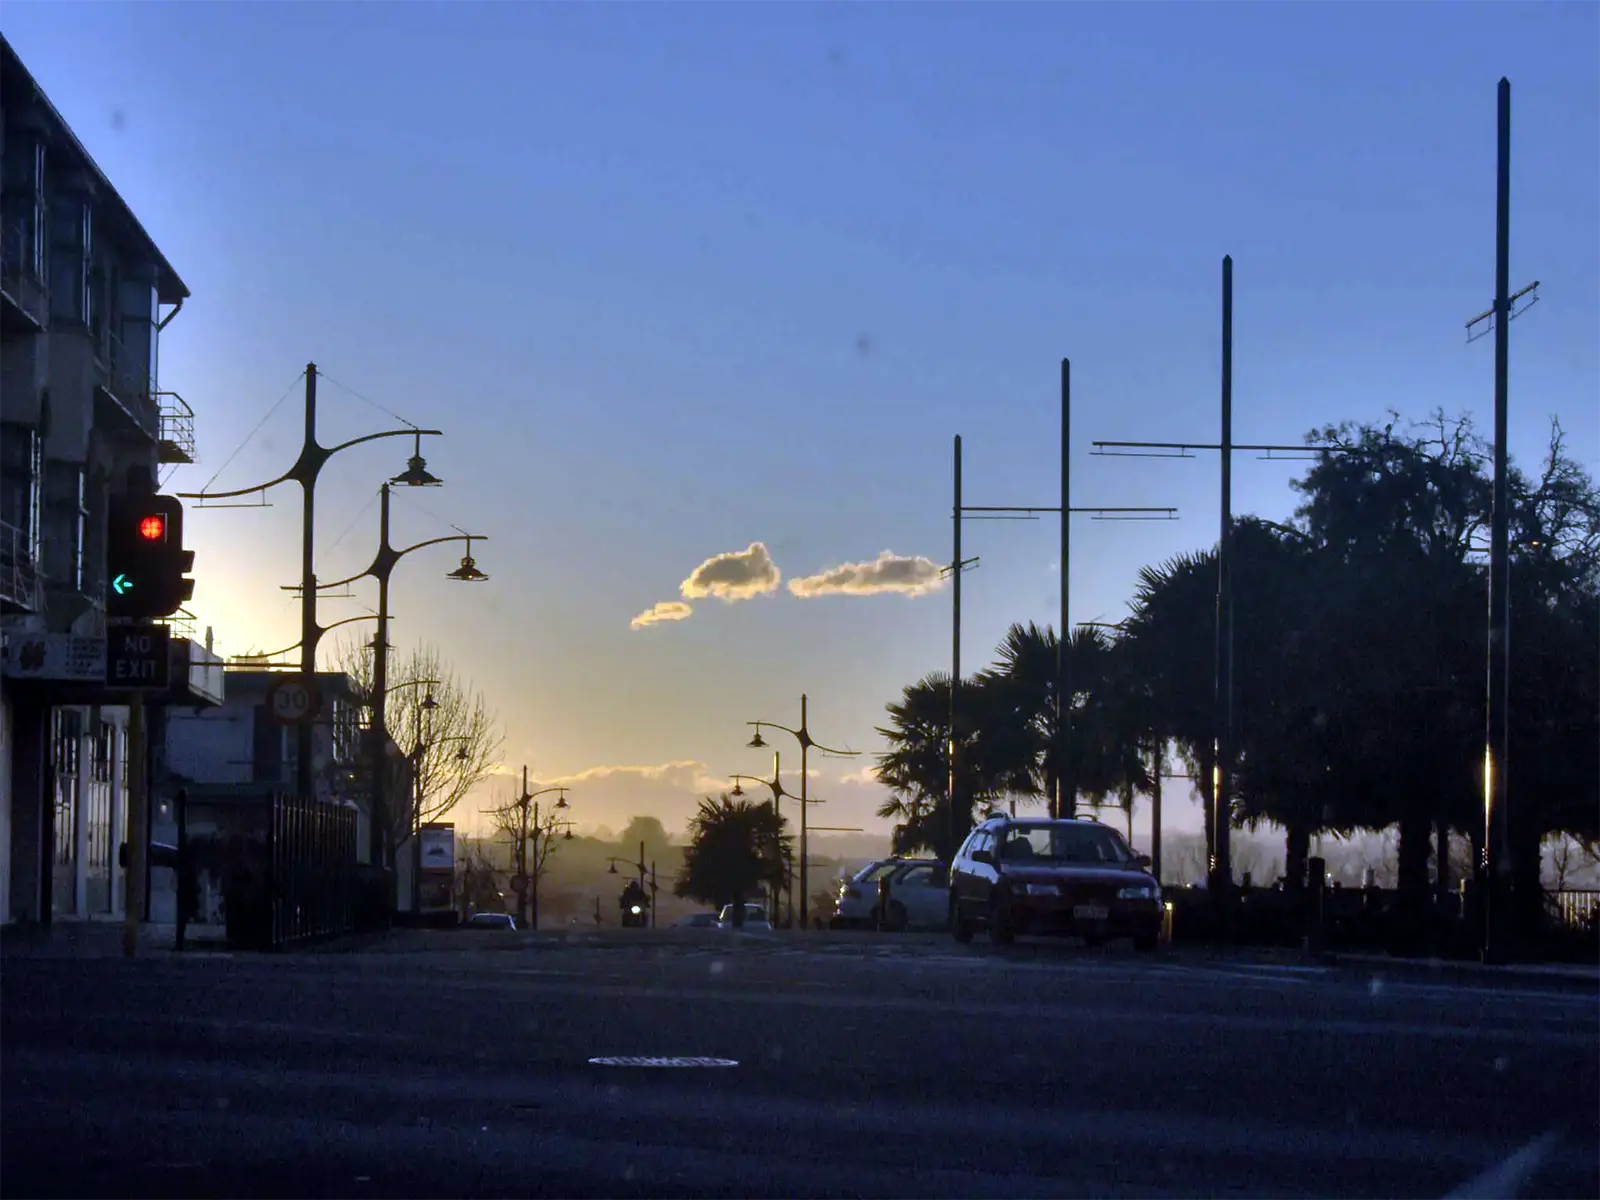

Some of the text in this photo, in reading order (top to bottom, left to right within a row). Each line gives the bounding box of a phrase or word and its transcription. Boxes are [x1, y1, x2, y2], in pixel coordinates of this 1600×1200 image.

[124, 633, 152, 654] NO
[116, 659, 157, 679] EXIT
[279, 690, 306, 710] 30
